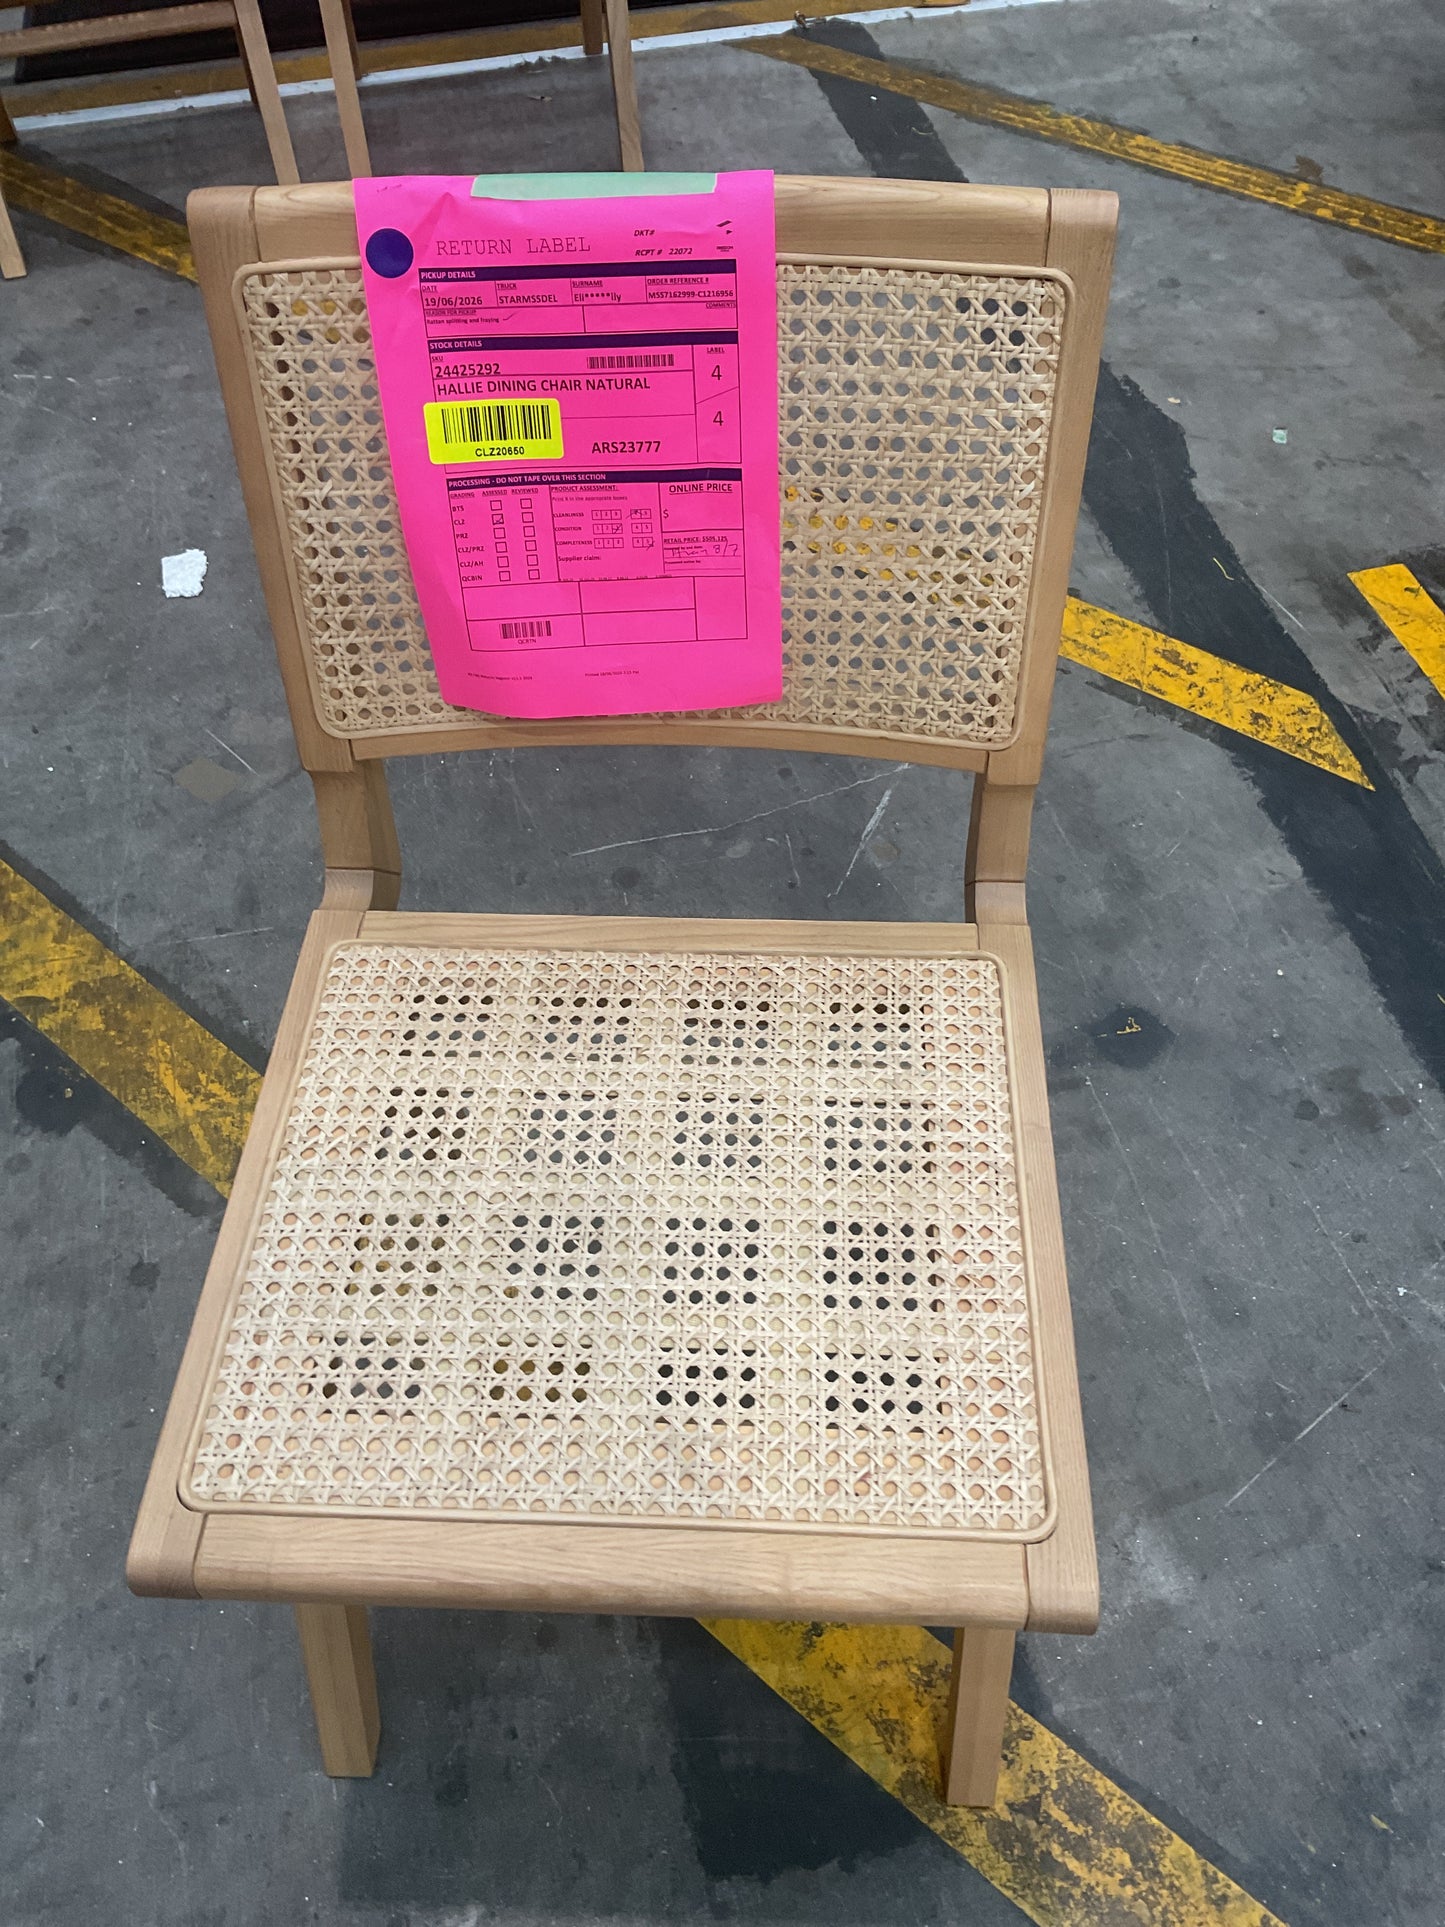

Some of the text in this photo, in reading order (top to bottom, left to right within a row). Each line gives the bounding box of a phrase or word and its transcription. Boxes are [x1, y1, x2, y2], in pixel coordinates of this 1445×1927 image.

[436, 237, 592, 256] RETURN LABEL
[668, 248, 693, 256] 22072
[420, 270, 476, 280] PICKUP DETAILS
[424, 296, 483, 307] 19/06/2026
[498, 294, 558, 305] STARMSSDEL
[430, 340, 482, 350] STOCK DETAILS
[434, 363, 501, 378] 24425292
[711, 364, 723, 380] 4
[437, 378, 650, 396] HALLIE DINING CHAIR NATURAL
[712, 411, 724, 426] 4
[475, 446, 525, 457] CLZ20650
[591, 440, 661, 454] ARS23777
[449, 478, 491, 487] PROCESSING
[561, 473, 577, 481] THIS
[669, 483, 733, 493] ONLINE PRICE
[662, 508, 669, 519] $
